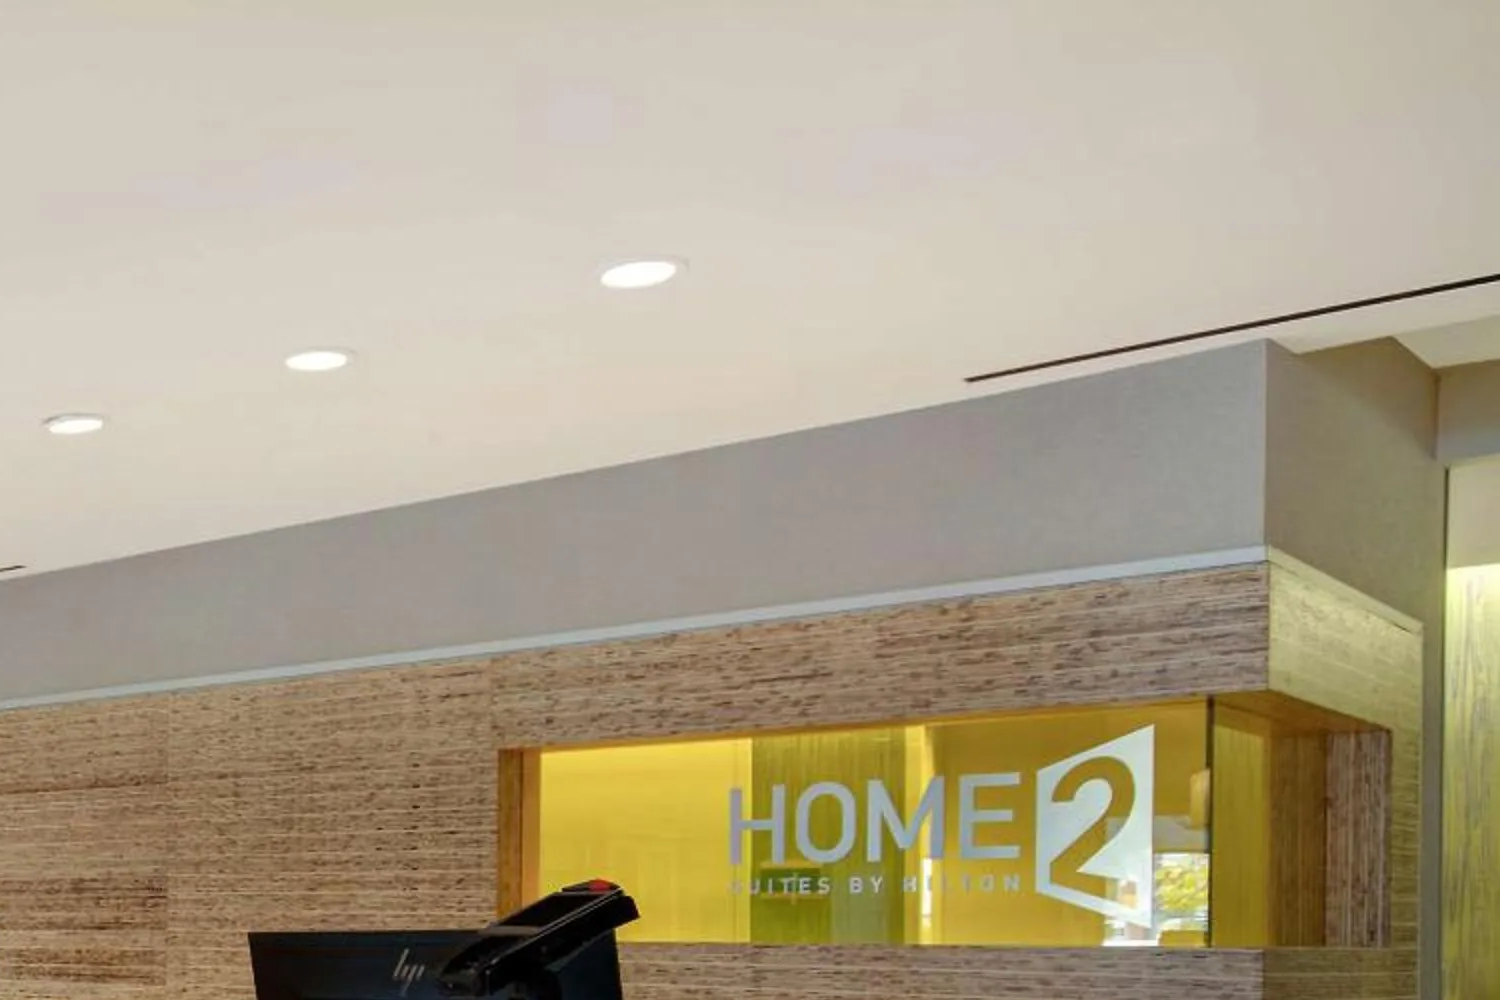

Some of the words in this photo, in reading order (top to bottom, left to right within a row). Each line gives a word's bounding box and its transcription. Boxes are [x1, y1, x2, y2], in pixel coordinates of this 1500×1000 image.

[728, 771, 1021, 865] HOME
[1049, 755, 1137, 910] 2
[850, 876, 882, 894] BY
[903, 874, 1020, 893] HITON
[393, 948, 425, 996] hp
